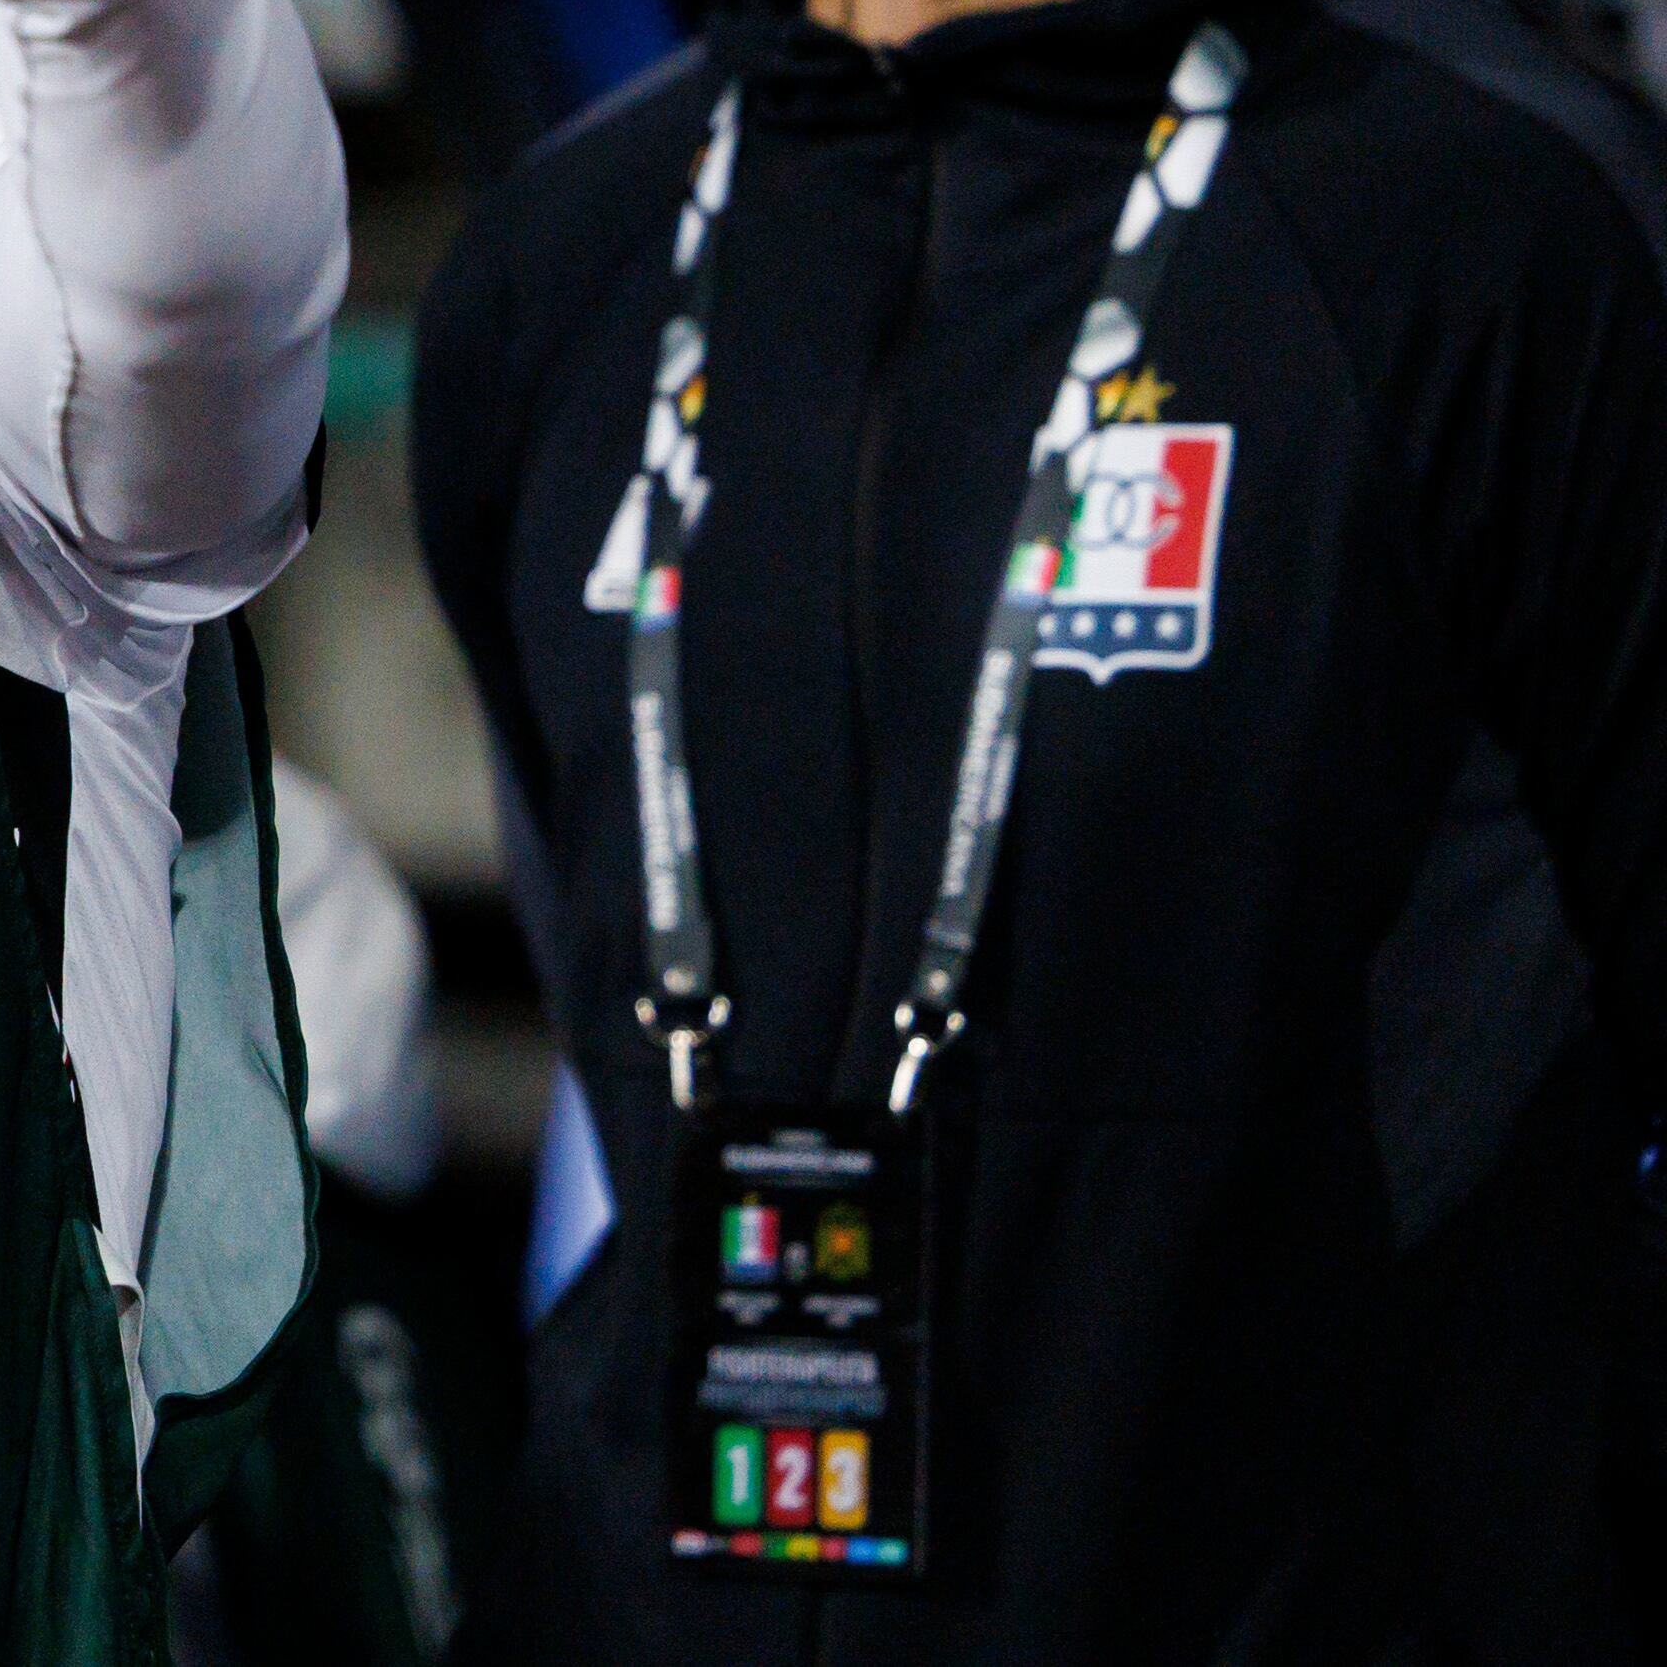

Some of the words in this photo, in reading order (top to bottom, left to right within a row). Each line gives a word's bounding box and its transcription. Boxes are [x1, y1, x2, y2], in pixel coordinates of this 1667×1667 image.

[727, 1444, 749, 1506] 1
[774, 1444, 809, 1510] 2
[827, 1447, 861, 1512] 3
